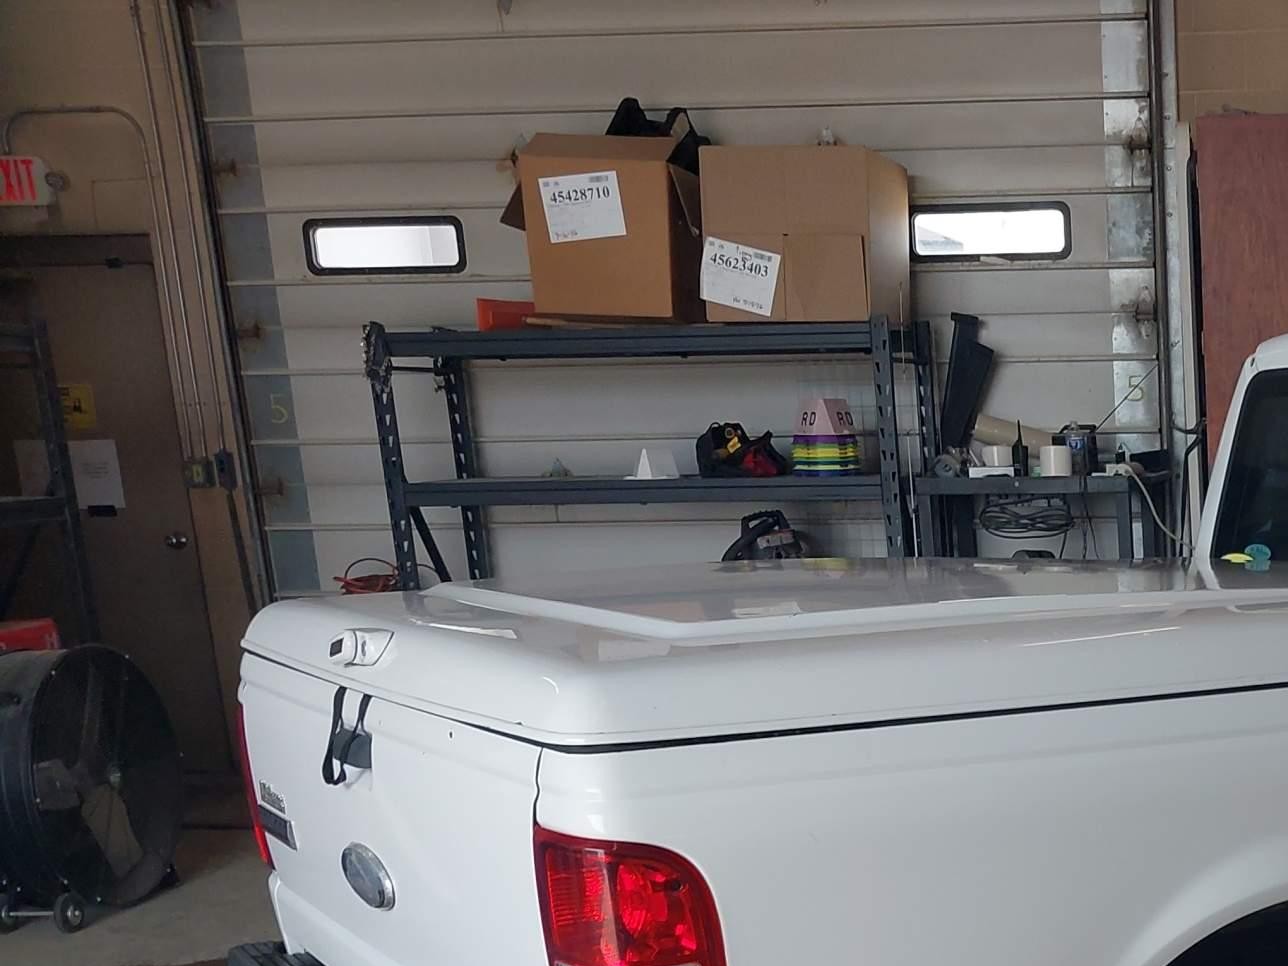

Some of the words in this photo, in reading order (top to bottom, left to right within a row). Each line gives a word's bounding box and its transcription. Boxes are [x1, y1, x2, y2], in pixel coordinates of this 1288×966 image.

[0, 159, 36, 201] XIT
[550, 185, 610, 205] 45428710
[710, 252, 769, 278] 45623403
[1128, 374, 1145, 402] 5
[270, 392, 289, 424] 5
